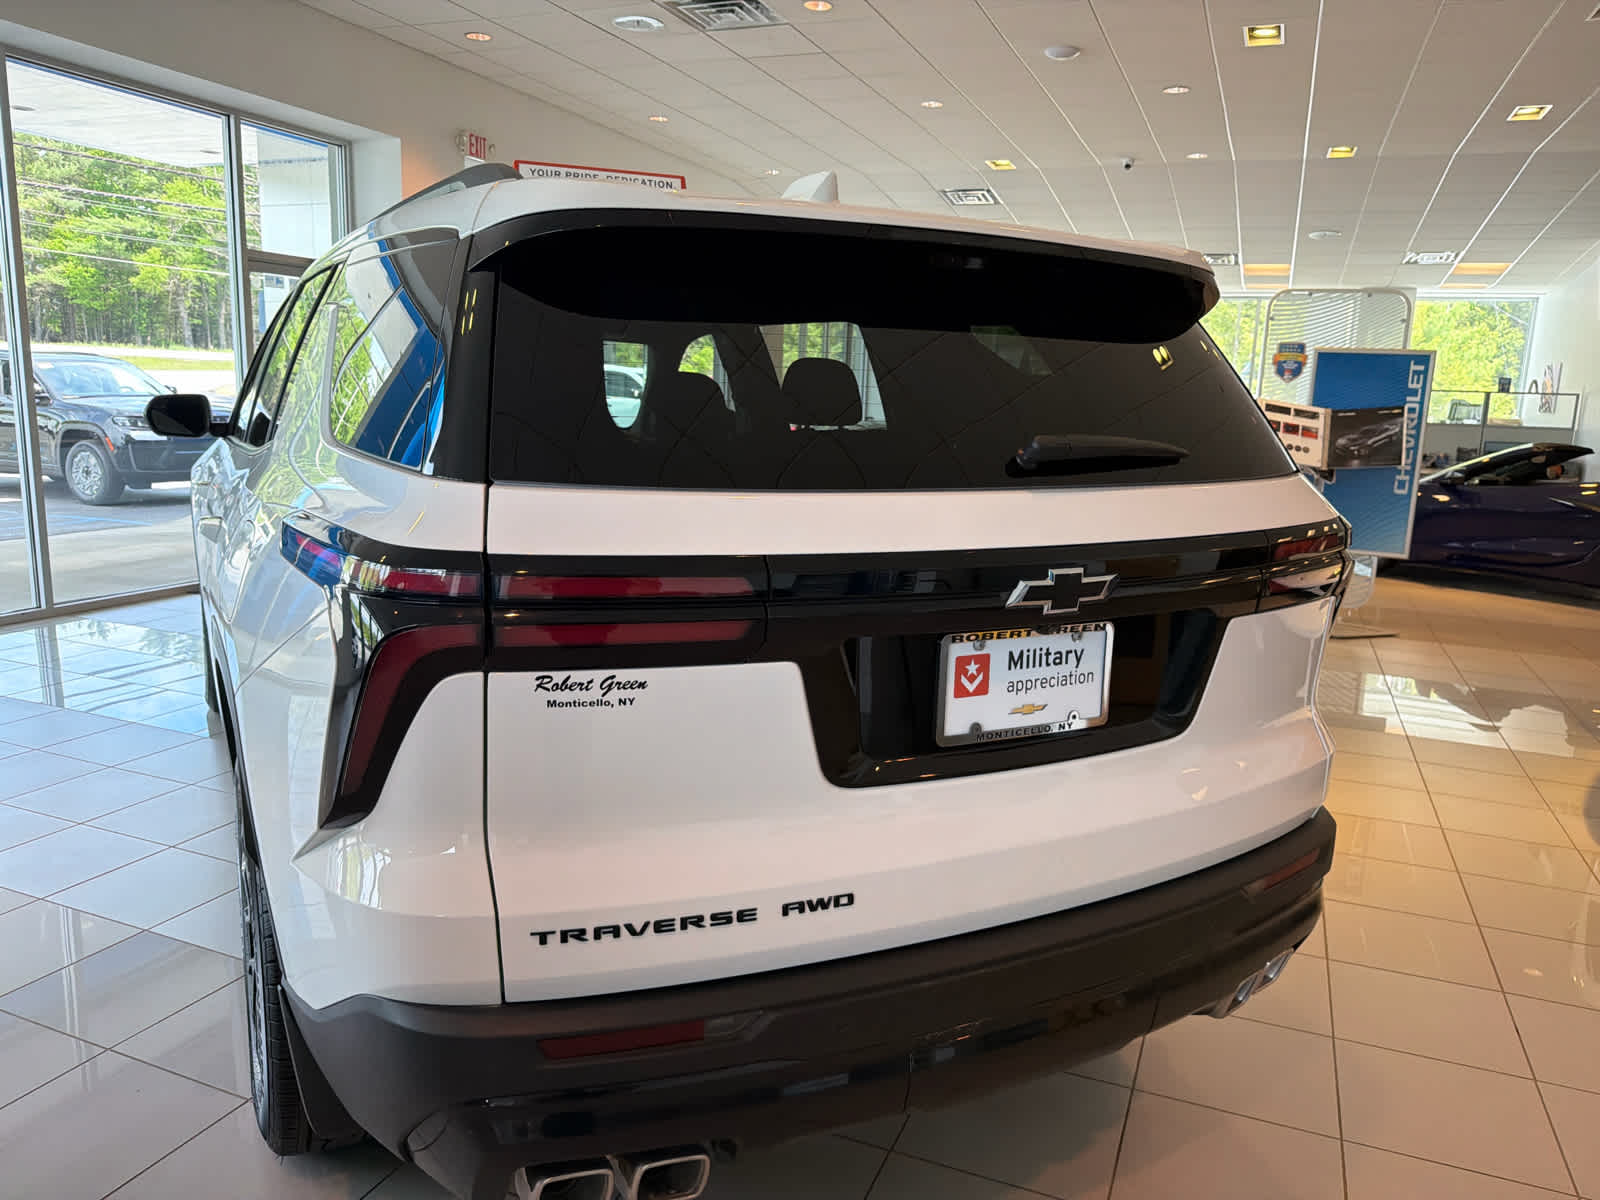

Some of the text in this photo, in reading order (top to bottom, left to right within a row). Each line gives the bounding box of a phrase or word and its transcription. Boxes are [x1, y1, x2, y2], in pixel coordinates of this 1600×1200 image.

[469, 132, 486, 159] EXIT
[529, 168, 561, 178] YOUR
[1393, 360, 1425, 494] CHEVROLET
[951, 623, 1107, 644] ROBERT REEN
[1008, 647, 1085, 671] Military
[534, 674, 648, 698] Robert Green
[1006, 670, 1094, 696] appreciation
[546, 697, 636, 708] Monticello, NY
[1058, 721, 1074, 731] NY
[530, 892, 855, 946] TRAVERSE AWD
